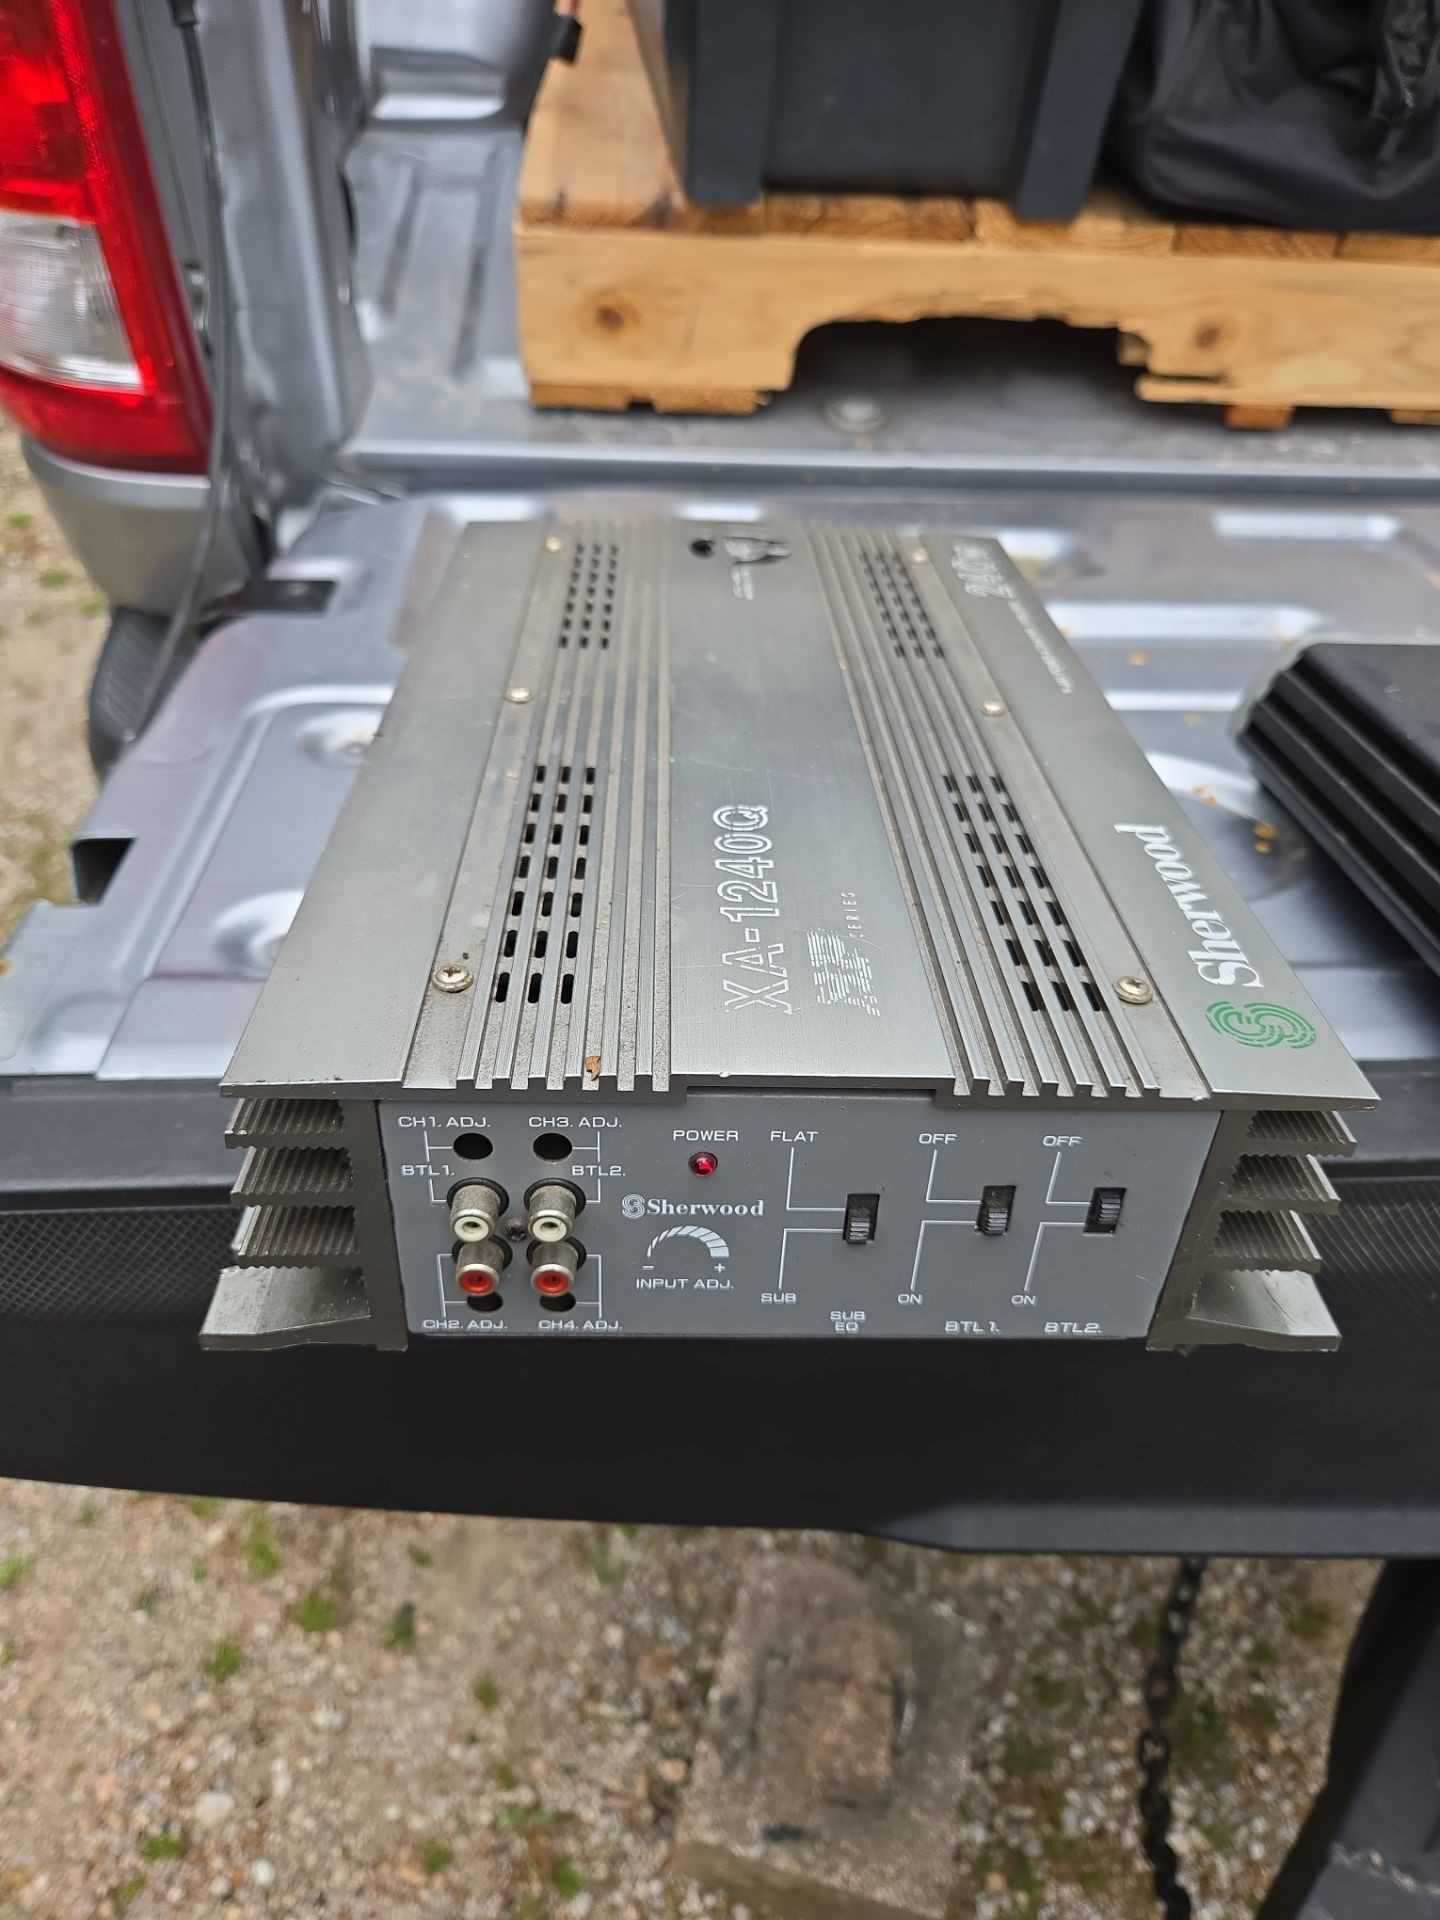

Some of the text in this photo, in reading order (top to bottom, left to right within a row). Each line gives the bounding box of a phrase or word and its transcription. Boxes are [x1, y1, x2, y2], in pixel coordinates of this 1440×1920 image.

[713, 805, 793, 1016] XA-1240Q
[1113, 822, 1264, 988] Sherwood
[398, 1116, 492, 1129] CH1. ADJ.
[528, 1116, 623, 1129] CH3. ADJ.
[673, 1129, 739, 1142] POWER
[770, 1131, 819, 1143] FLAT
[919, 1133, 958, 1145] OFF
[1042, 1135, 1083, 1148] OFF
[401, 1165, 456, 1177] BTL1.
[571, 1165, 626, 1177] BTL2.
[646, 1199, 765, 1217] Sherwood
[635, 1278, 734, 1290] INPUT ADJ.
[760, 1292, 797, 1304] SUB
[897, 1293, 923, 1306] ON
[1011, 1295, 1037, 1307] ON
[830, 1311, 866, 1322] SUB
[423, 1319, 508, 1331] CH2. ADJ.
[538, 1319, 623, 1331] CH4. ADJ.
[834, 1322, 860, 1334] EQ
[1044, 1321, 1102, 1334] BTL2.
